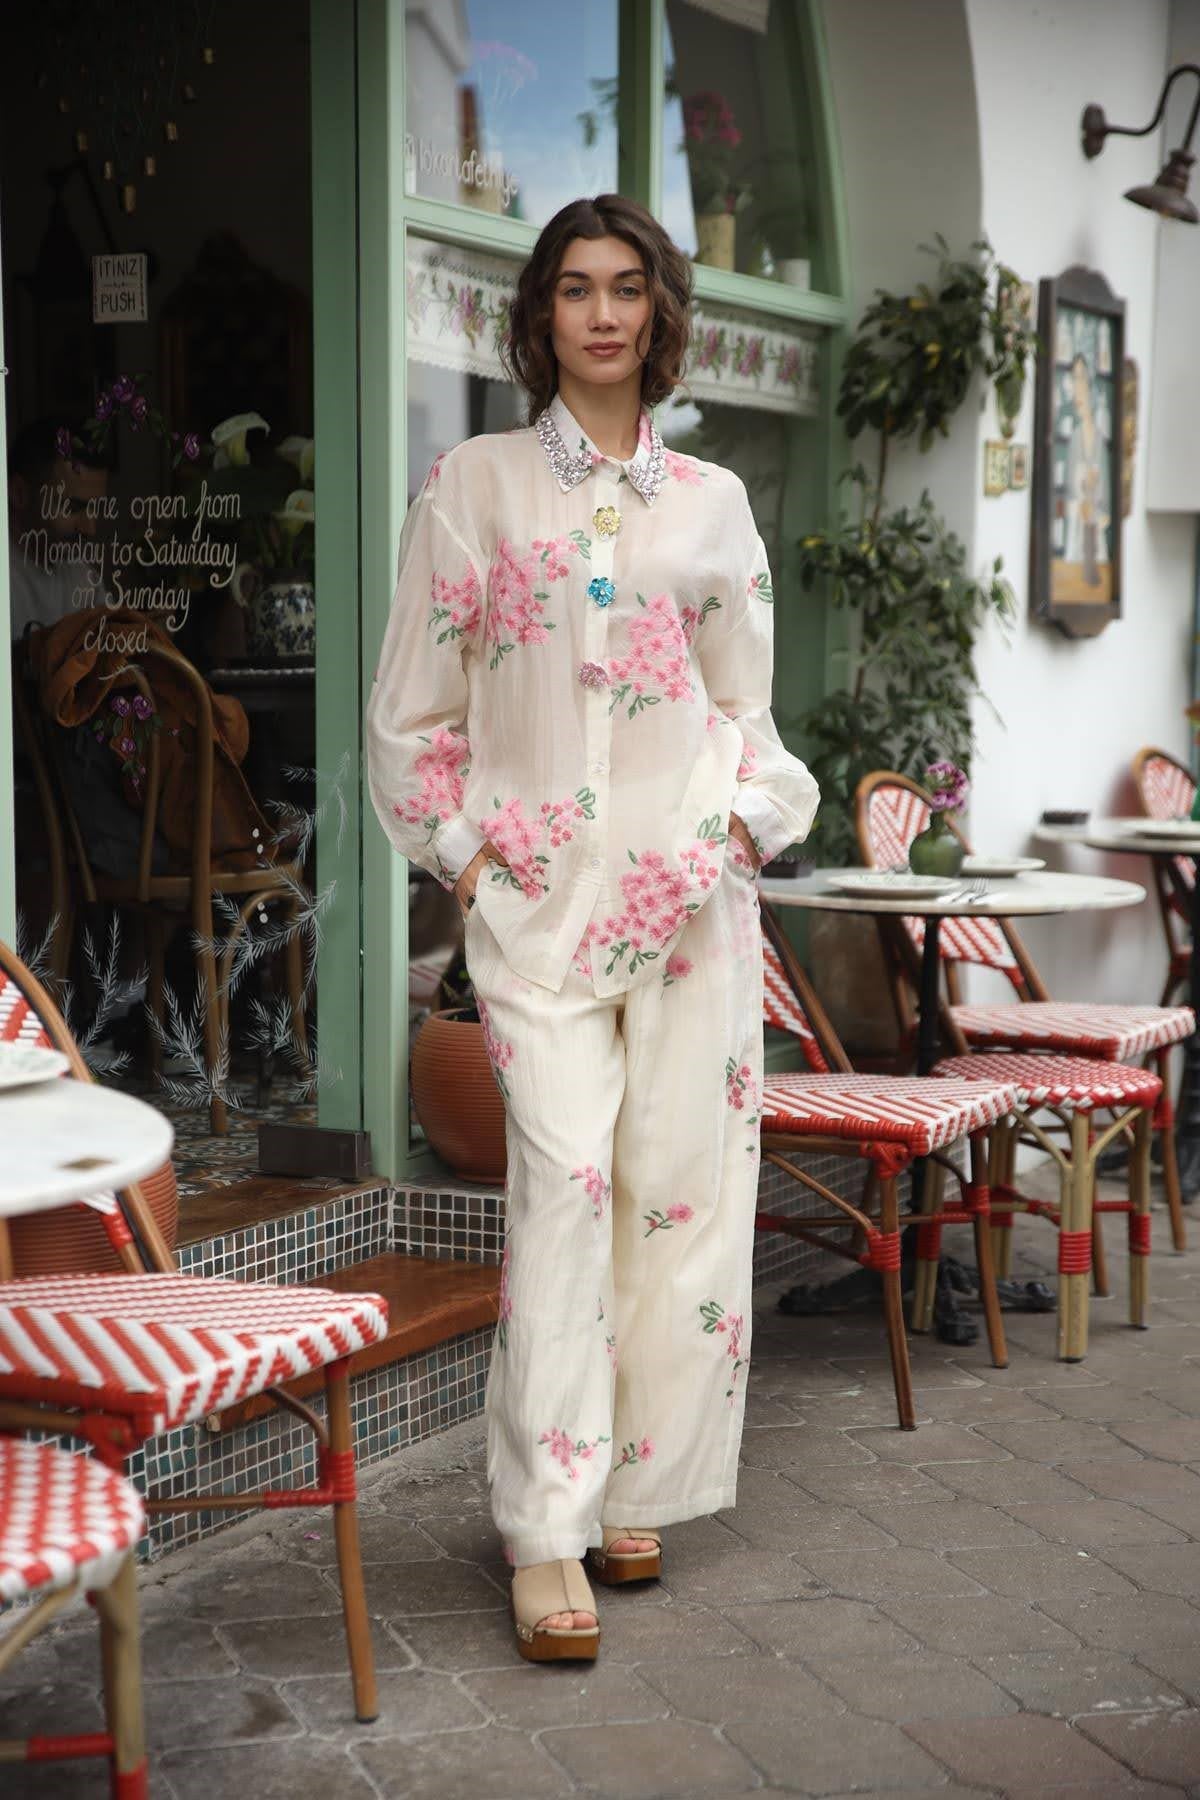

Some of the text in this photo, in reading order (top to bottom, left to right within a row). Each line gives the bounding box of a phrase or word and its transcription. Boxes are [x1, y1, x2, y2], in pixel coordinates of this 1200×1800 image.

[101, 291, 136, 312] PUSH
[40, 480, 241, 542] We are open from
[19, 528, 237, 588] Monday to Saturday
[72, 569, 191, 632] on Sunday
[84, 615, 149, 654] closed
